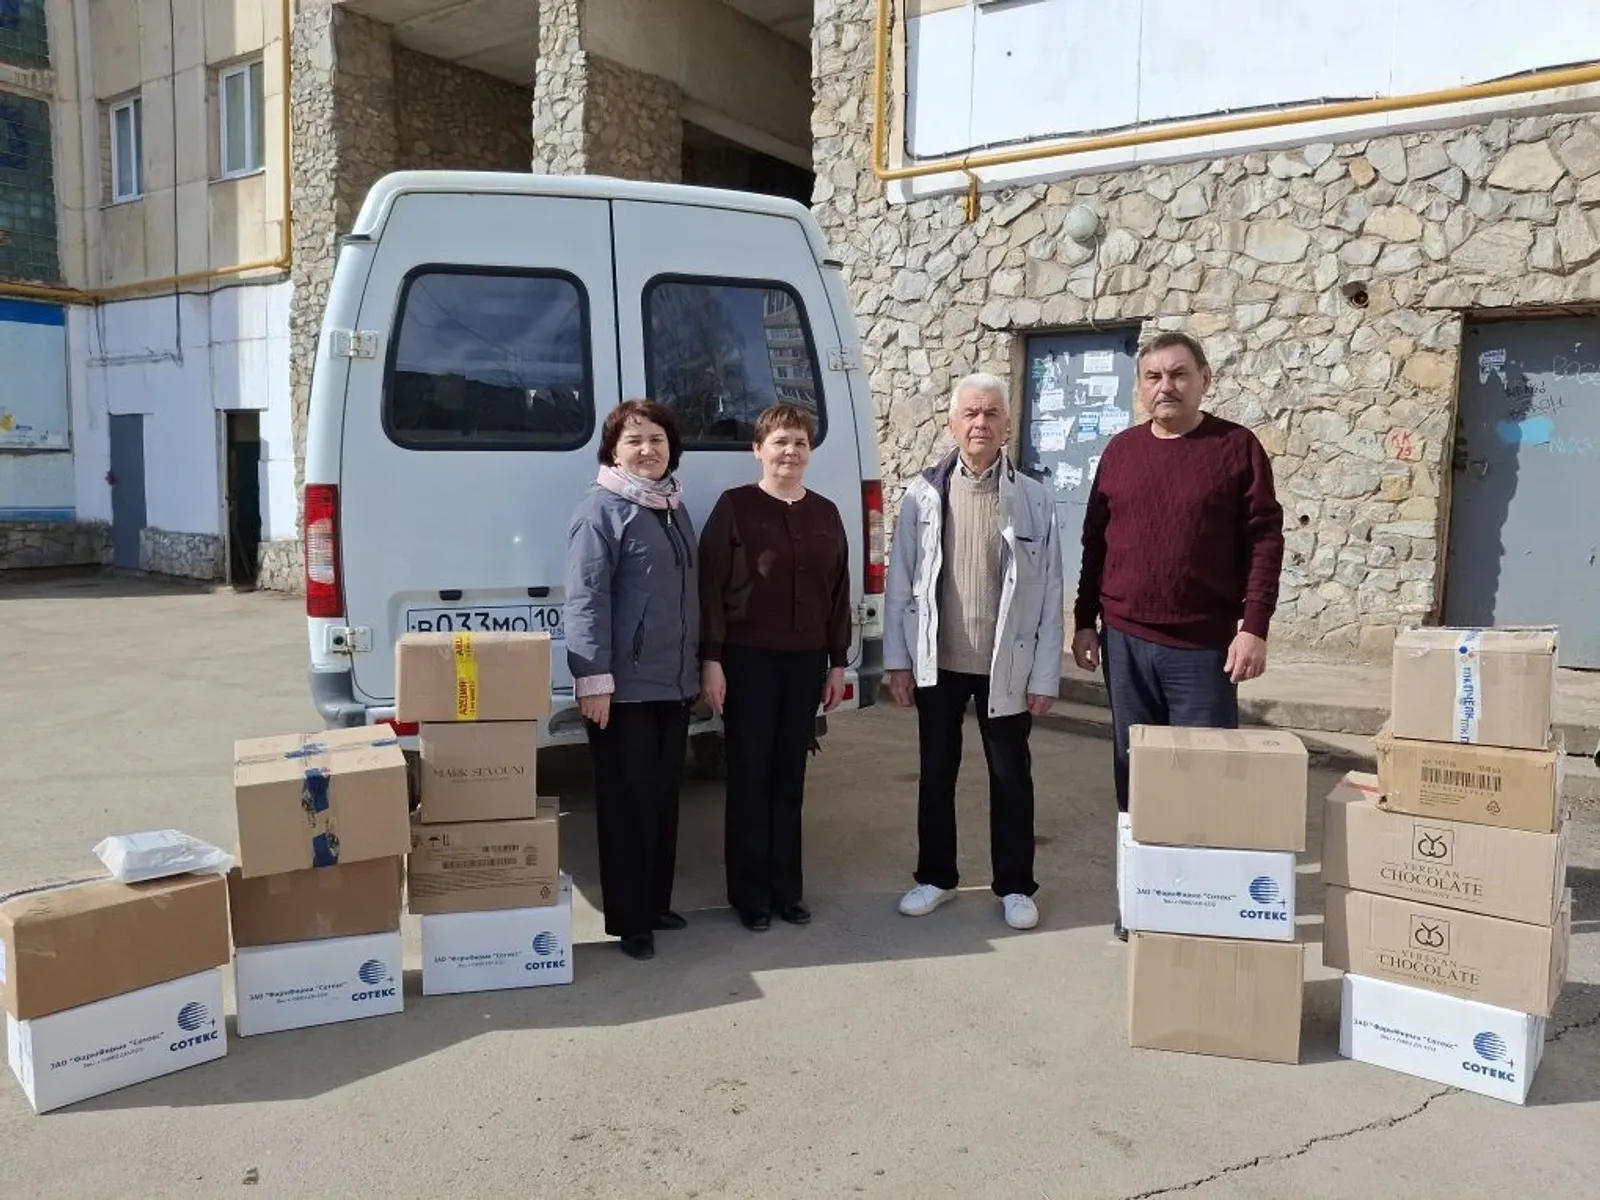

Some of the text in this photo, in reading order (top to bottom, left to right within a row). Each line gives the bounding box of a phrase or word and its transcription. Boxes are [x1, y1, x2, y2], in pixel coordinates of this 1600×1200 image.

[534, 608, 564, 628] 10
[1380, 867, 1483, 897] CHOCOLATE
[1239, 909, 1288, 921] СОТЕКС
[525, 960, 566, 971] СОТЕКС
[1379, 953, 1481, 986] CHOCOLATE
[352, 988, 396, 1002] СОТЕКС
[170, 1030, 218, 1052] СОТЕКС
[1462, 1061, 1516, 1083] СОТЕКС
